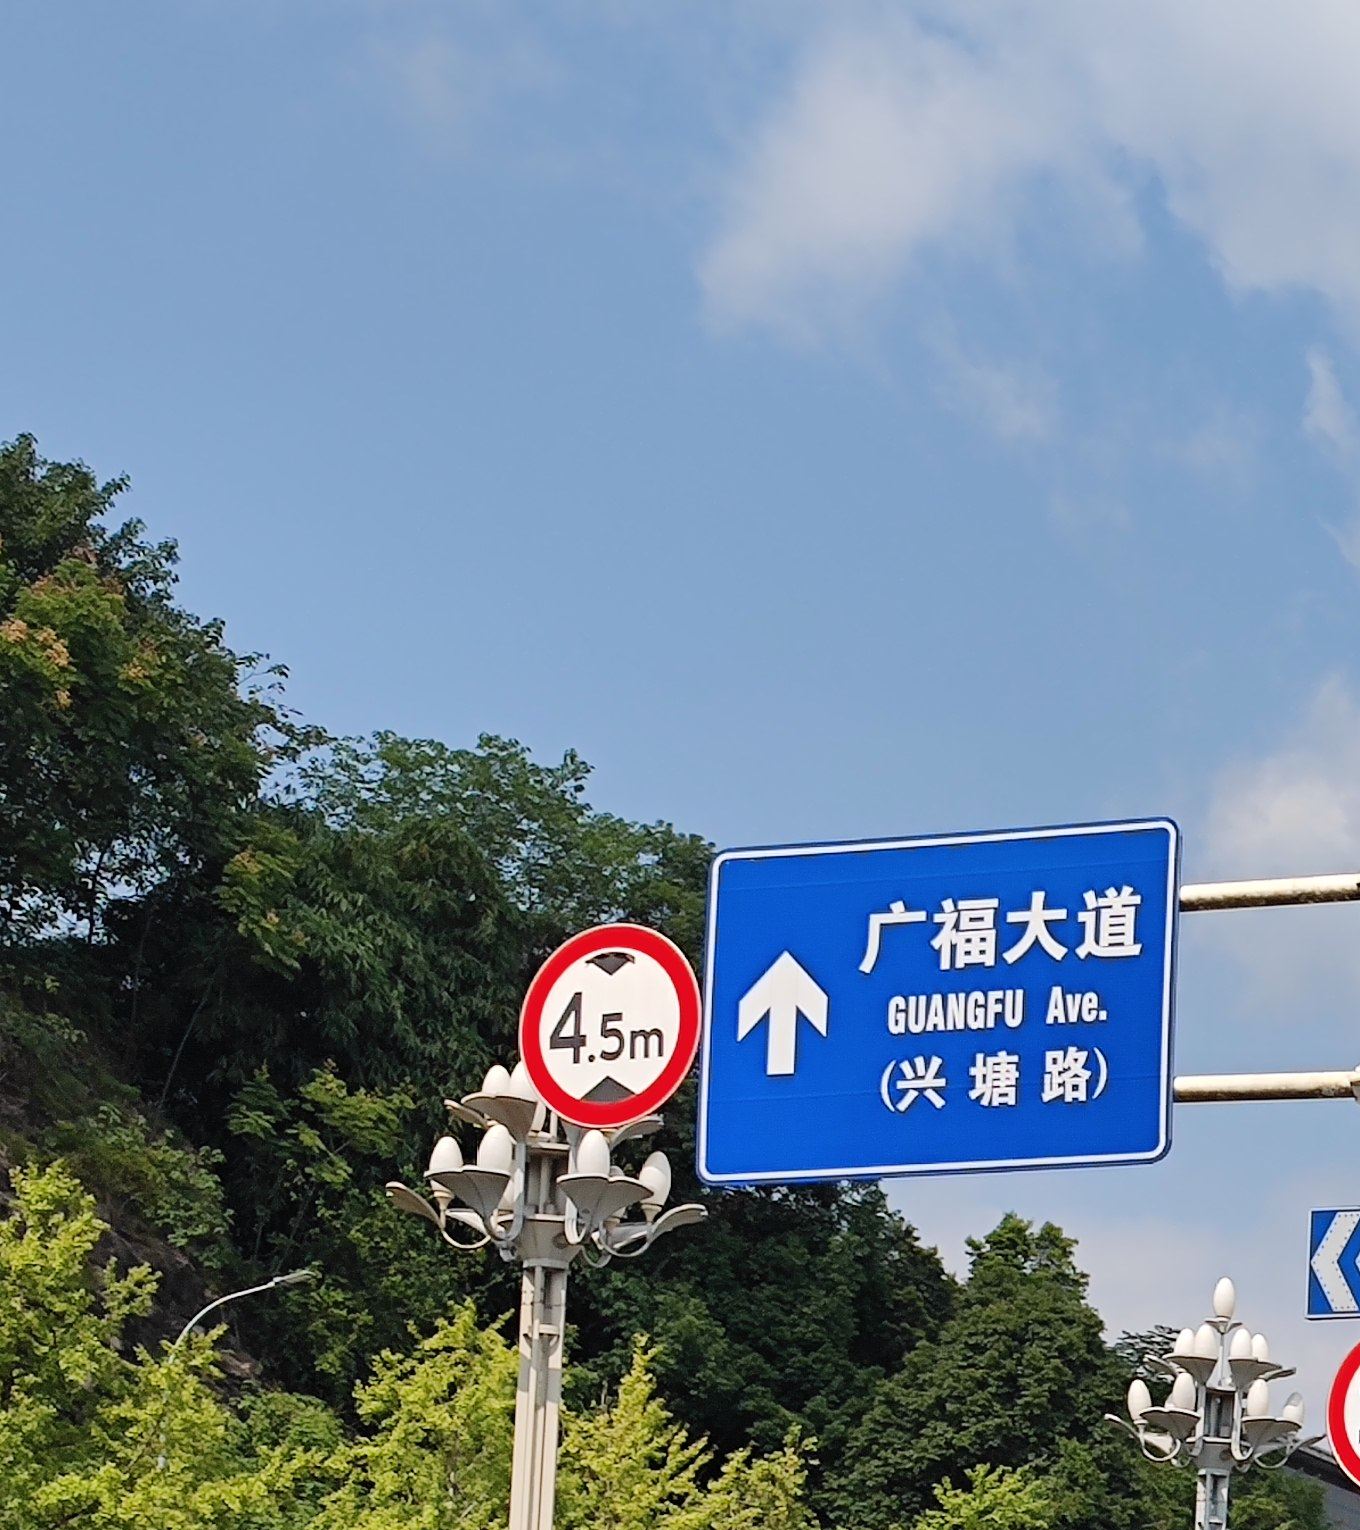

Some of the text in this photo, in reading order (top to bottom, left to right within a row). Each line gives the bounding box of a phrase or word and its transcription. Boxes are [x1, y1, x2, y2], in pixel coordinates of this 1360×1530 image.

[860, 885, 1144, 974] 广福大道
[549, 993, 665, 1065] 4.5m
[887, 987, 1108, 1036] GUANGFU Ave.
